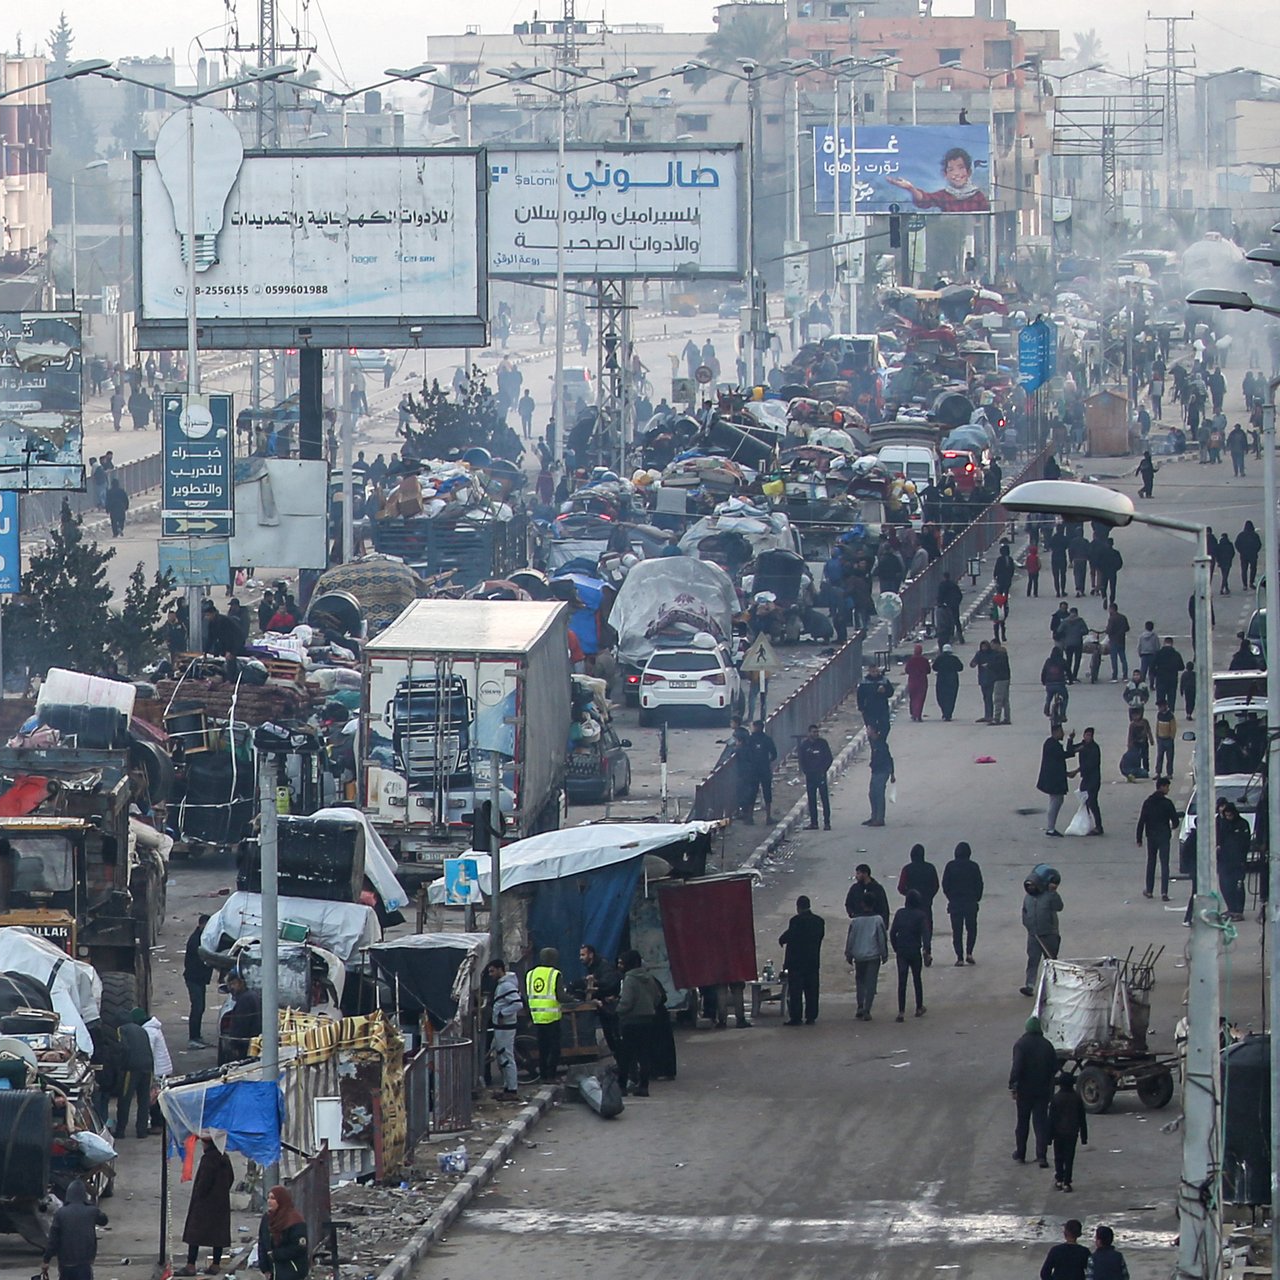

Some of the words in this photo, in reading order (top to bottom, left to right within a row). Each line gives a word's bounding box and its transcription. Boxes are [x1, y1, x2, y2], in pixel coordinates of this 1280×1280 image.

[823, 135, 899, 158] غزة
[566, 160, 720, 198] صالوني
[230, 209, 305, 230] والتمديدات
[400, 206, 448, 228] للأدوات
[514, 205, 607, 225] والبورسلان
[611, 206, 700, 226] للسيراميك
[514, 232, 625, 253] الصحية
[629, 235, 700, 254] والأدوات
[351, 254, 378, 264] hager
[194, 286, 249, 295] 8-2556155
[265, 285, 328, 295] 0599601988
[12, 378, 47, 393] للتجارة
[172, 446, 222, 458] خبراء
[170, 464, 222, 478] للتدريب
[172, 483, 223, 497] والتطوير
